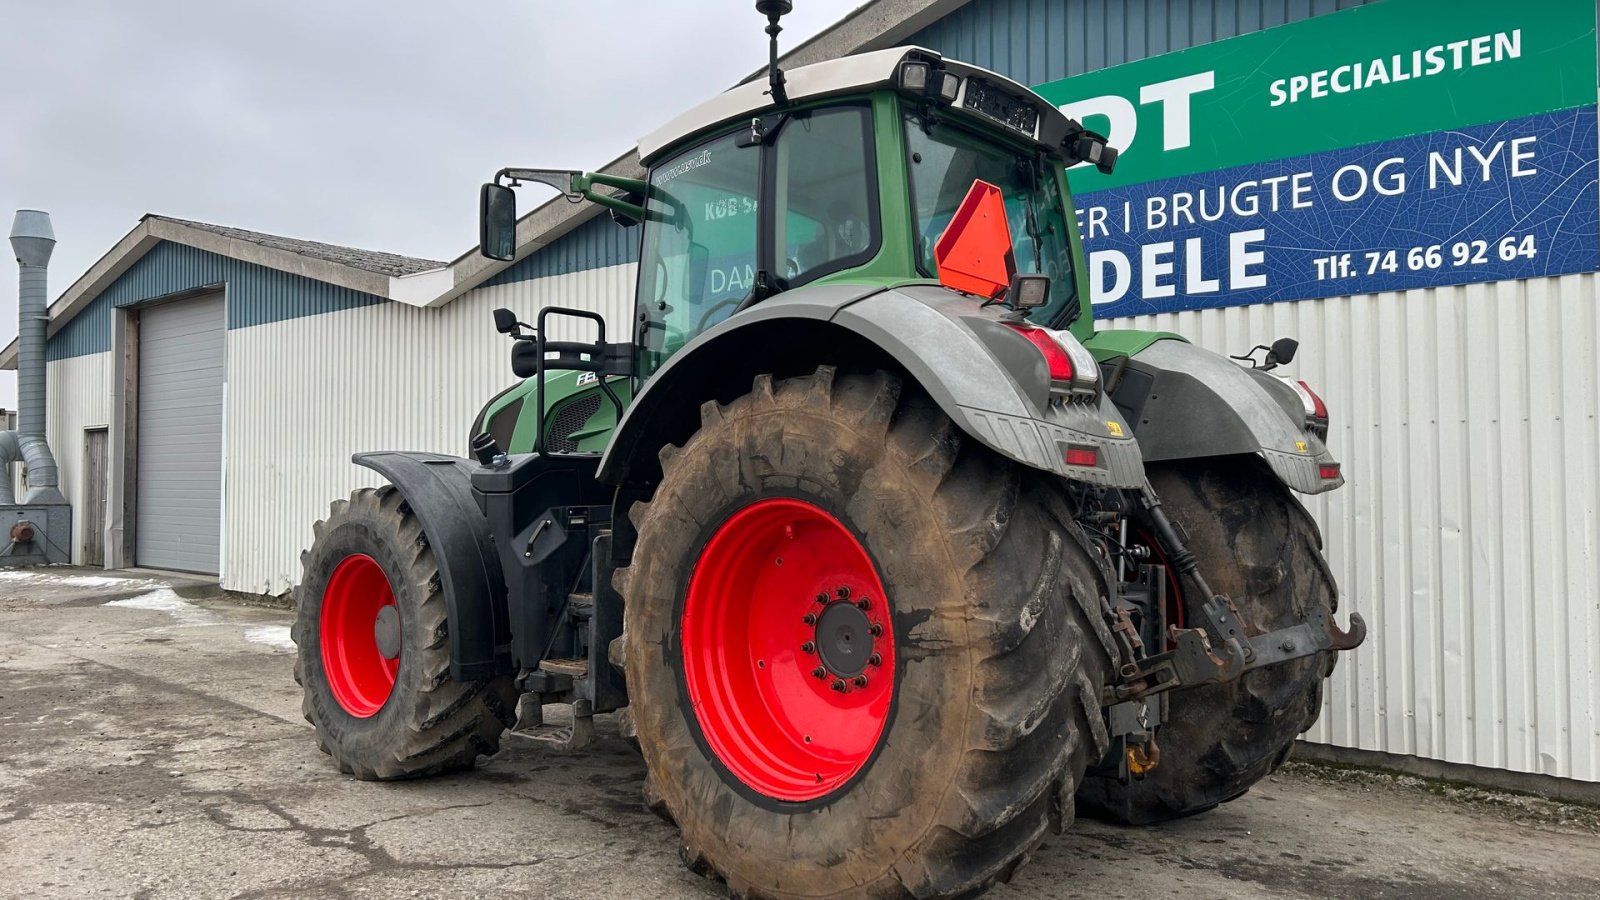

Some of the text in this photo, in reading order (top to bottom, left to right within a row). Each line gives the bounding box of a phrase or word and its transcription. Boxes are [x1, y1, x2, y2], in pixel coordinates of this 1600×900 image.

[1269, 28, 1522, 107] SPECIALISTEN
[1124, 201, 1131, 233] I
[1147, 171, 1313, 231] BRUGTE
[1332, 157, 1406, 202] OG
[1429, 136, 1538, 190] NYE
[1313, 234, 1537, 281] Tlf. 74 66 92 64
